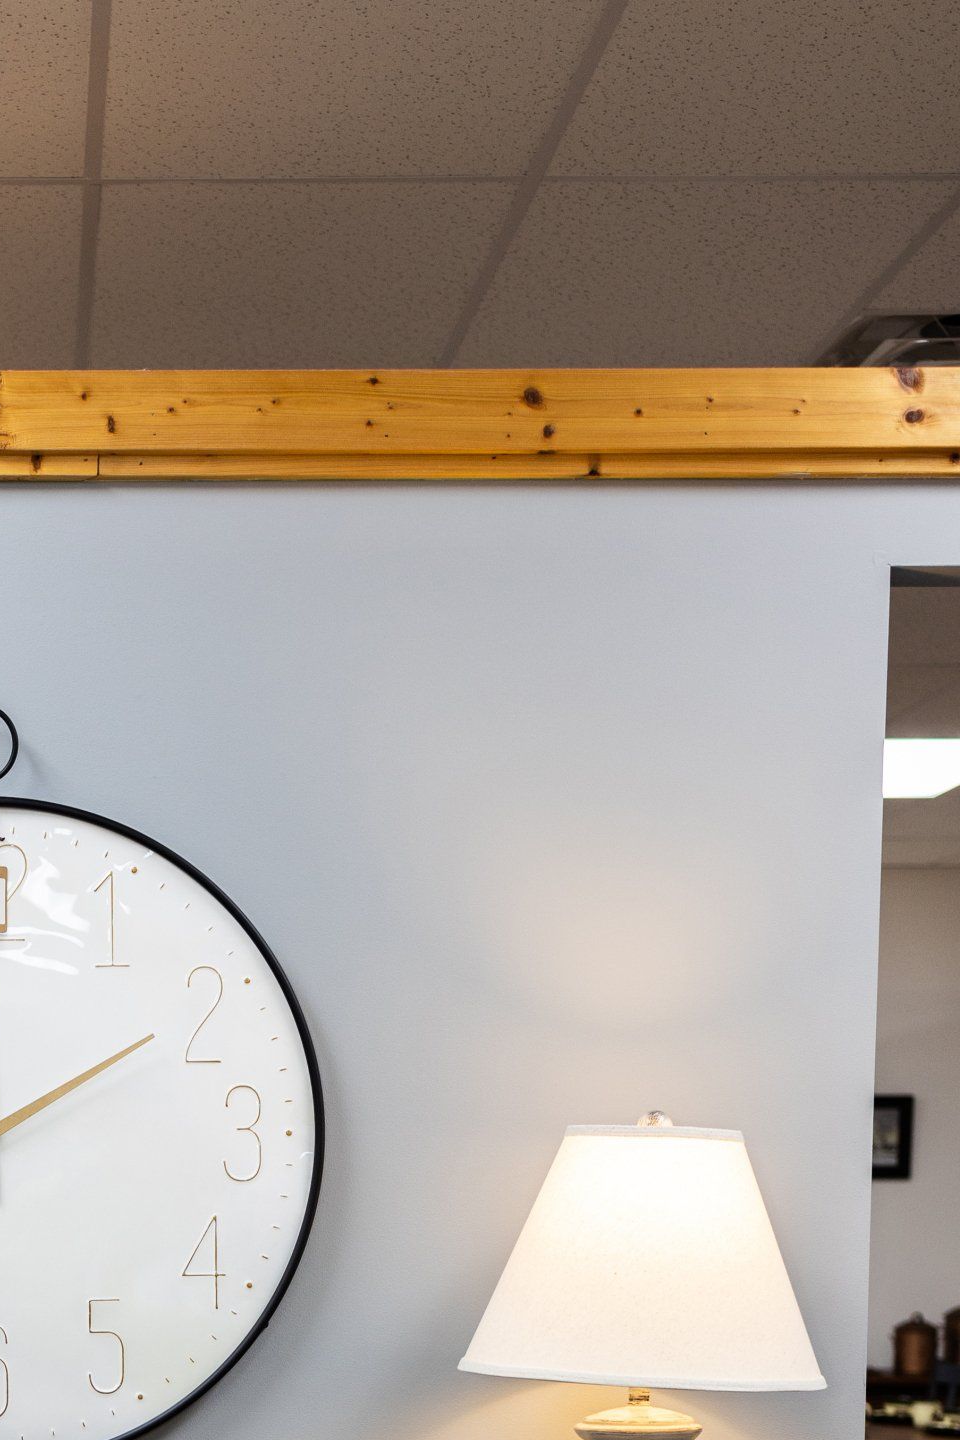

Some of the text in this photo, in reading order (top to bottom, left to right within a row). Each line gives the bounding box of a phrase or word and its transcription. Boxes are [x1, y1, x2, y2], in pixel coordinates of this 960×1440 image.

[93, 870, 131, 968] 1
[185, 965, 224, 1064] 2
[223, 1084, 263, 1182] 3
[181, 1214, 227, 1310] 4
[87, 1298, 125, 1395] 5
